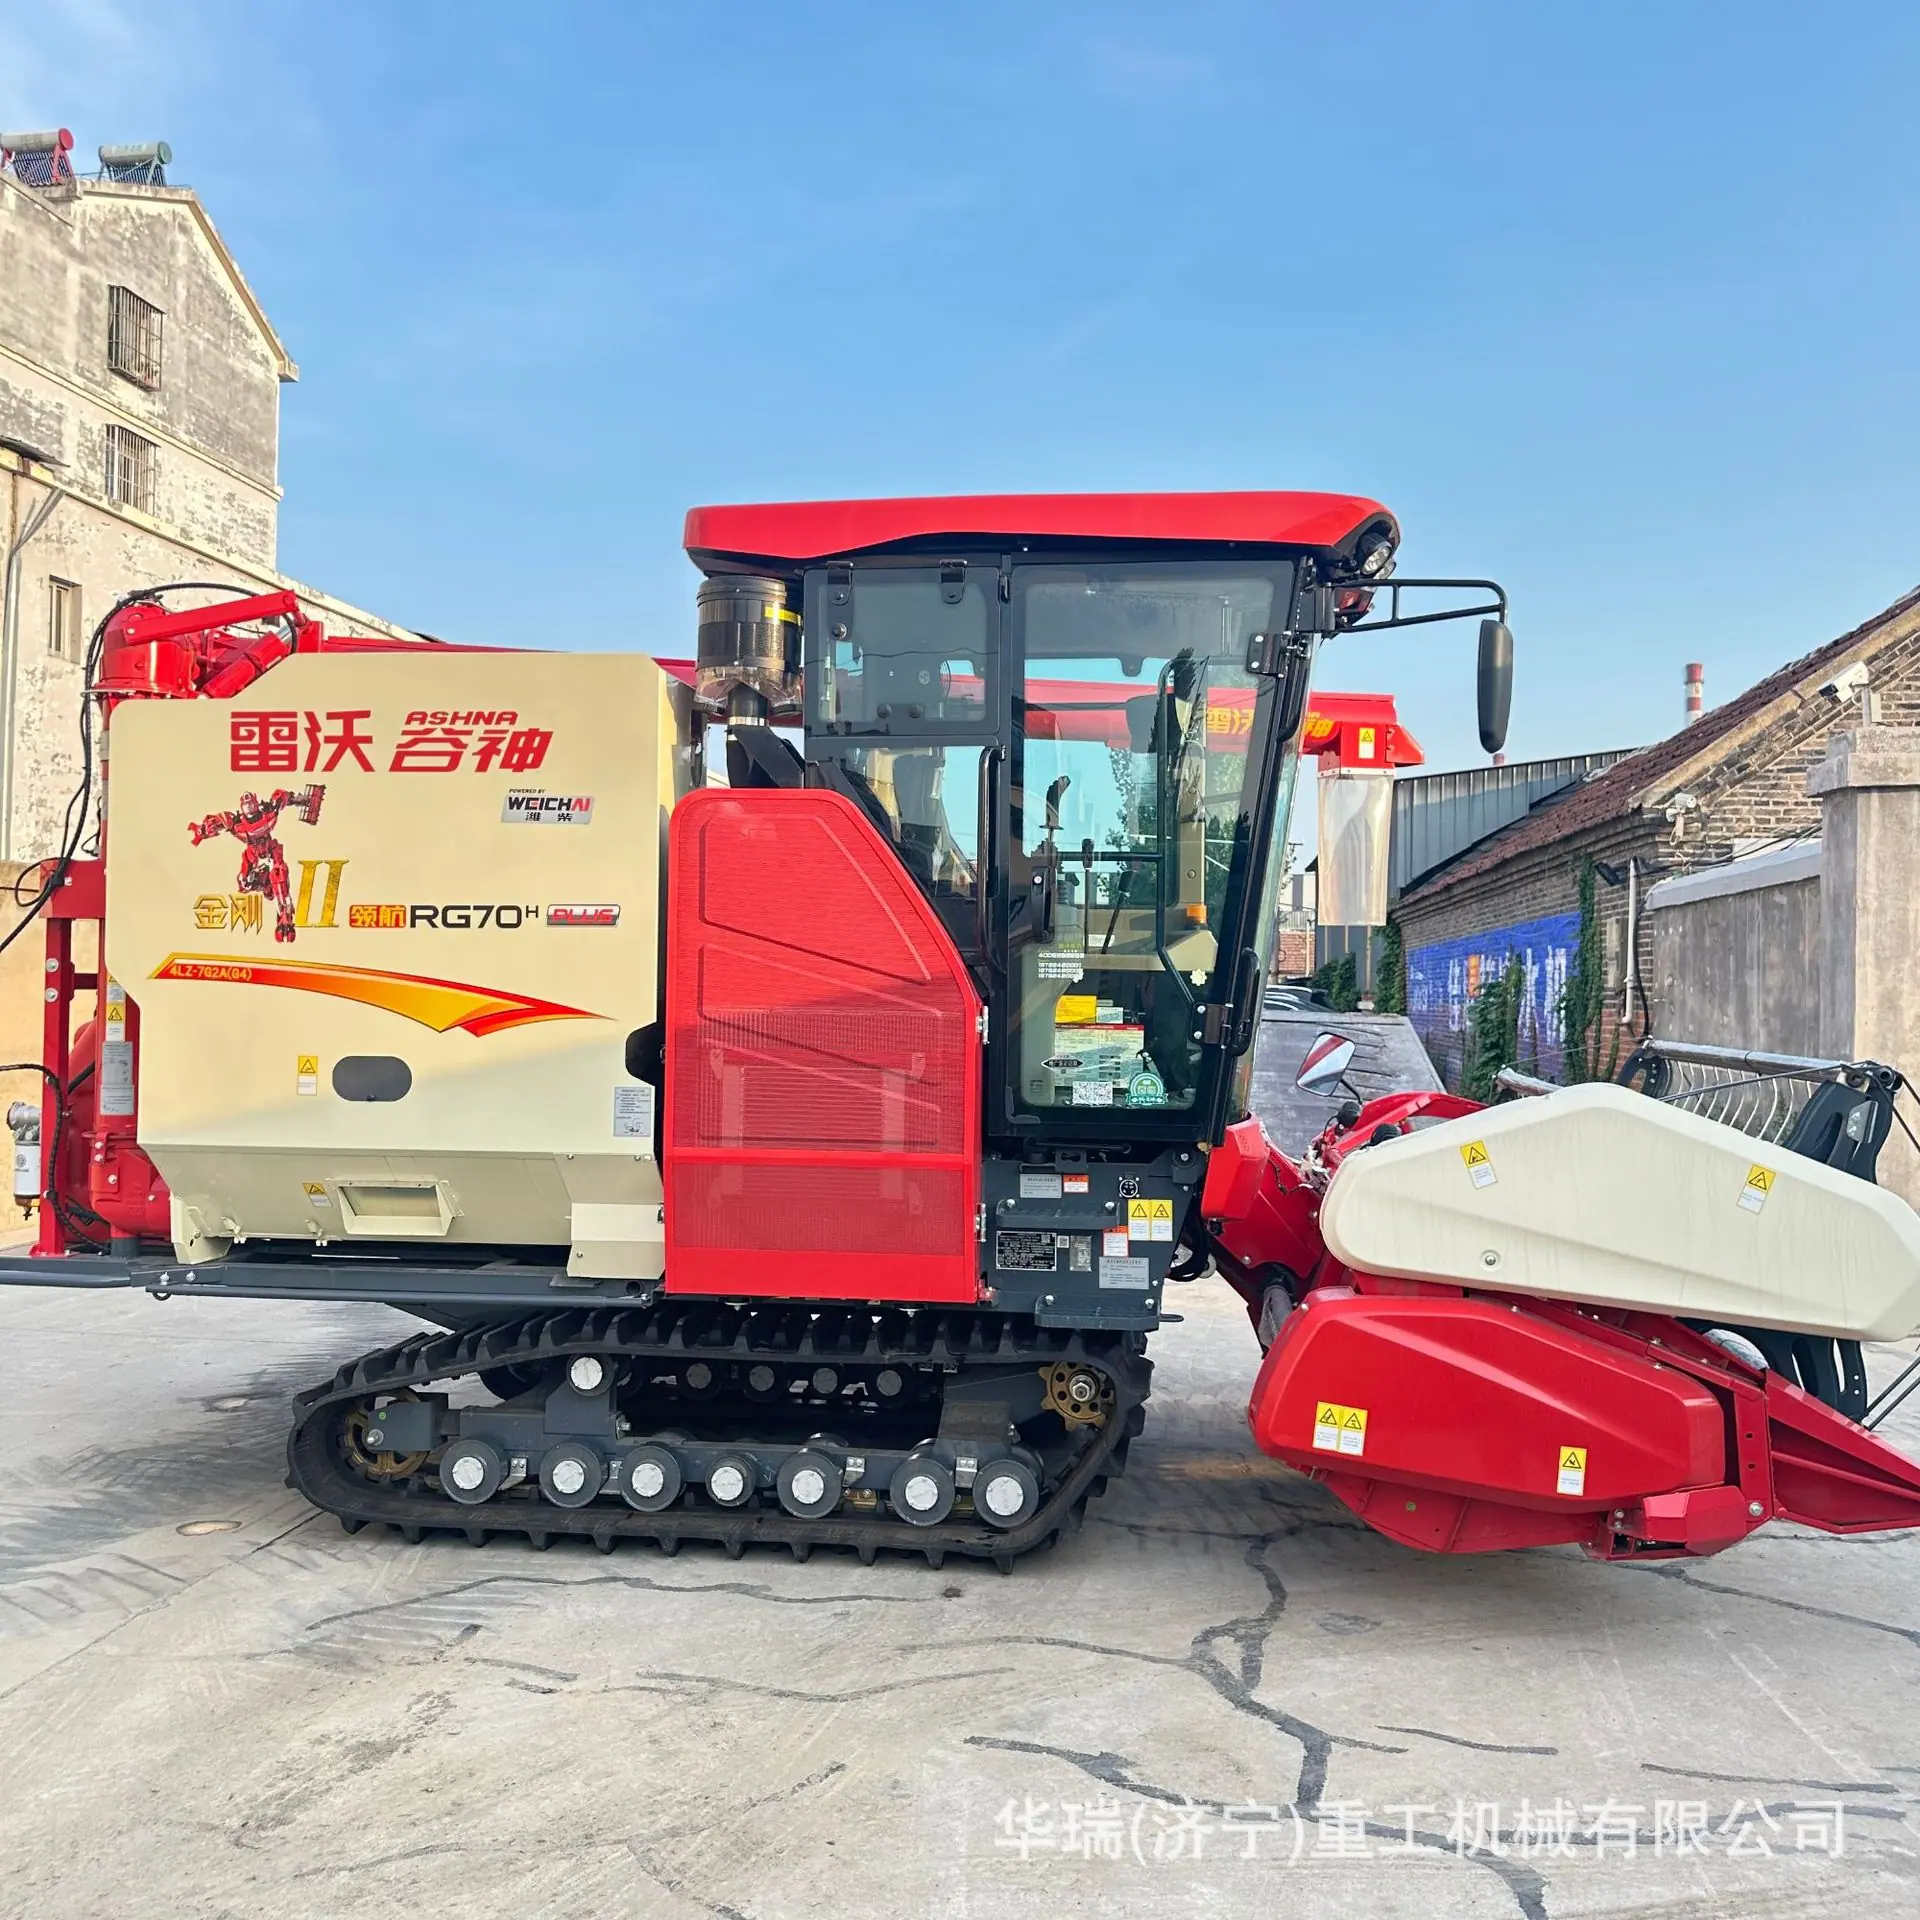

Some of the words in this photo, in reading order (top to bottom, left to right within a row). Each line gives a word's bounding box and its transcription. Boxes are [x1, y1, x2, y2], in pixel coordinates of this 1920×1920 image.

[404, 711, 519, 726] ASHNA
[230, 710, 376, 773] 雷沃
[389, 728, 554, 773] 谷神
[508, 796, 591, 812] WEICHAI
[525, 811, 573, 822] 潍柴
[193, 894, 263, 935] 金刚
[350, 904, 406, 928] 领航
[552, 908, 614, 923] PLUS
